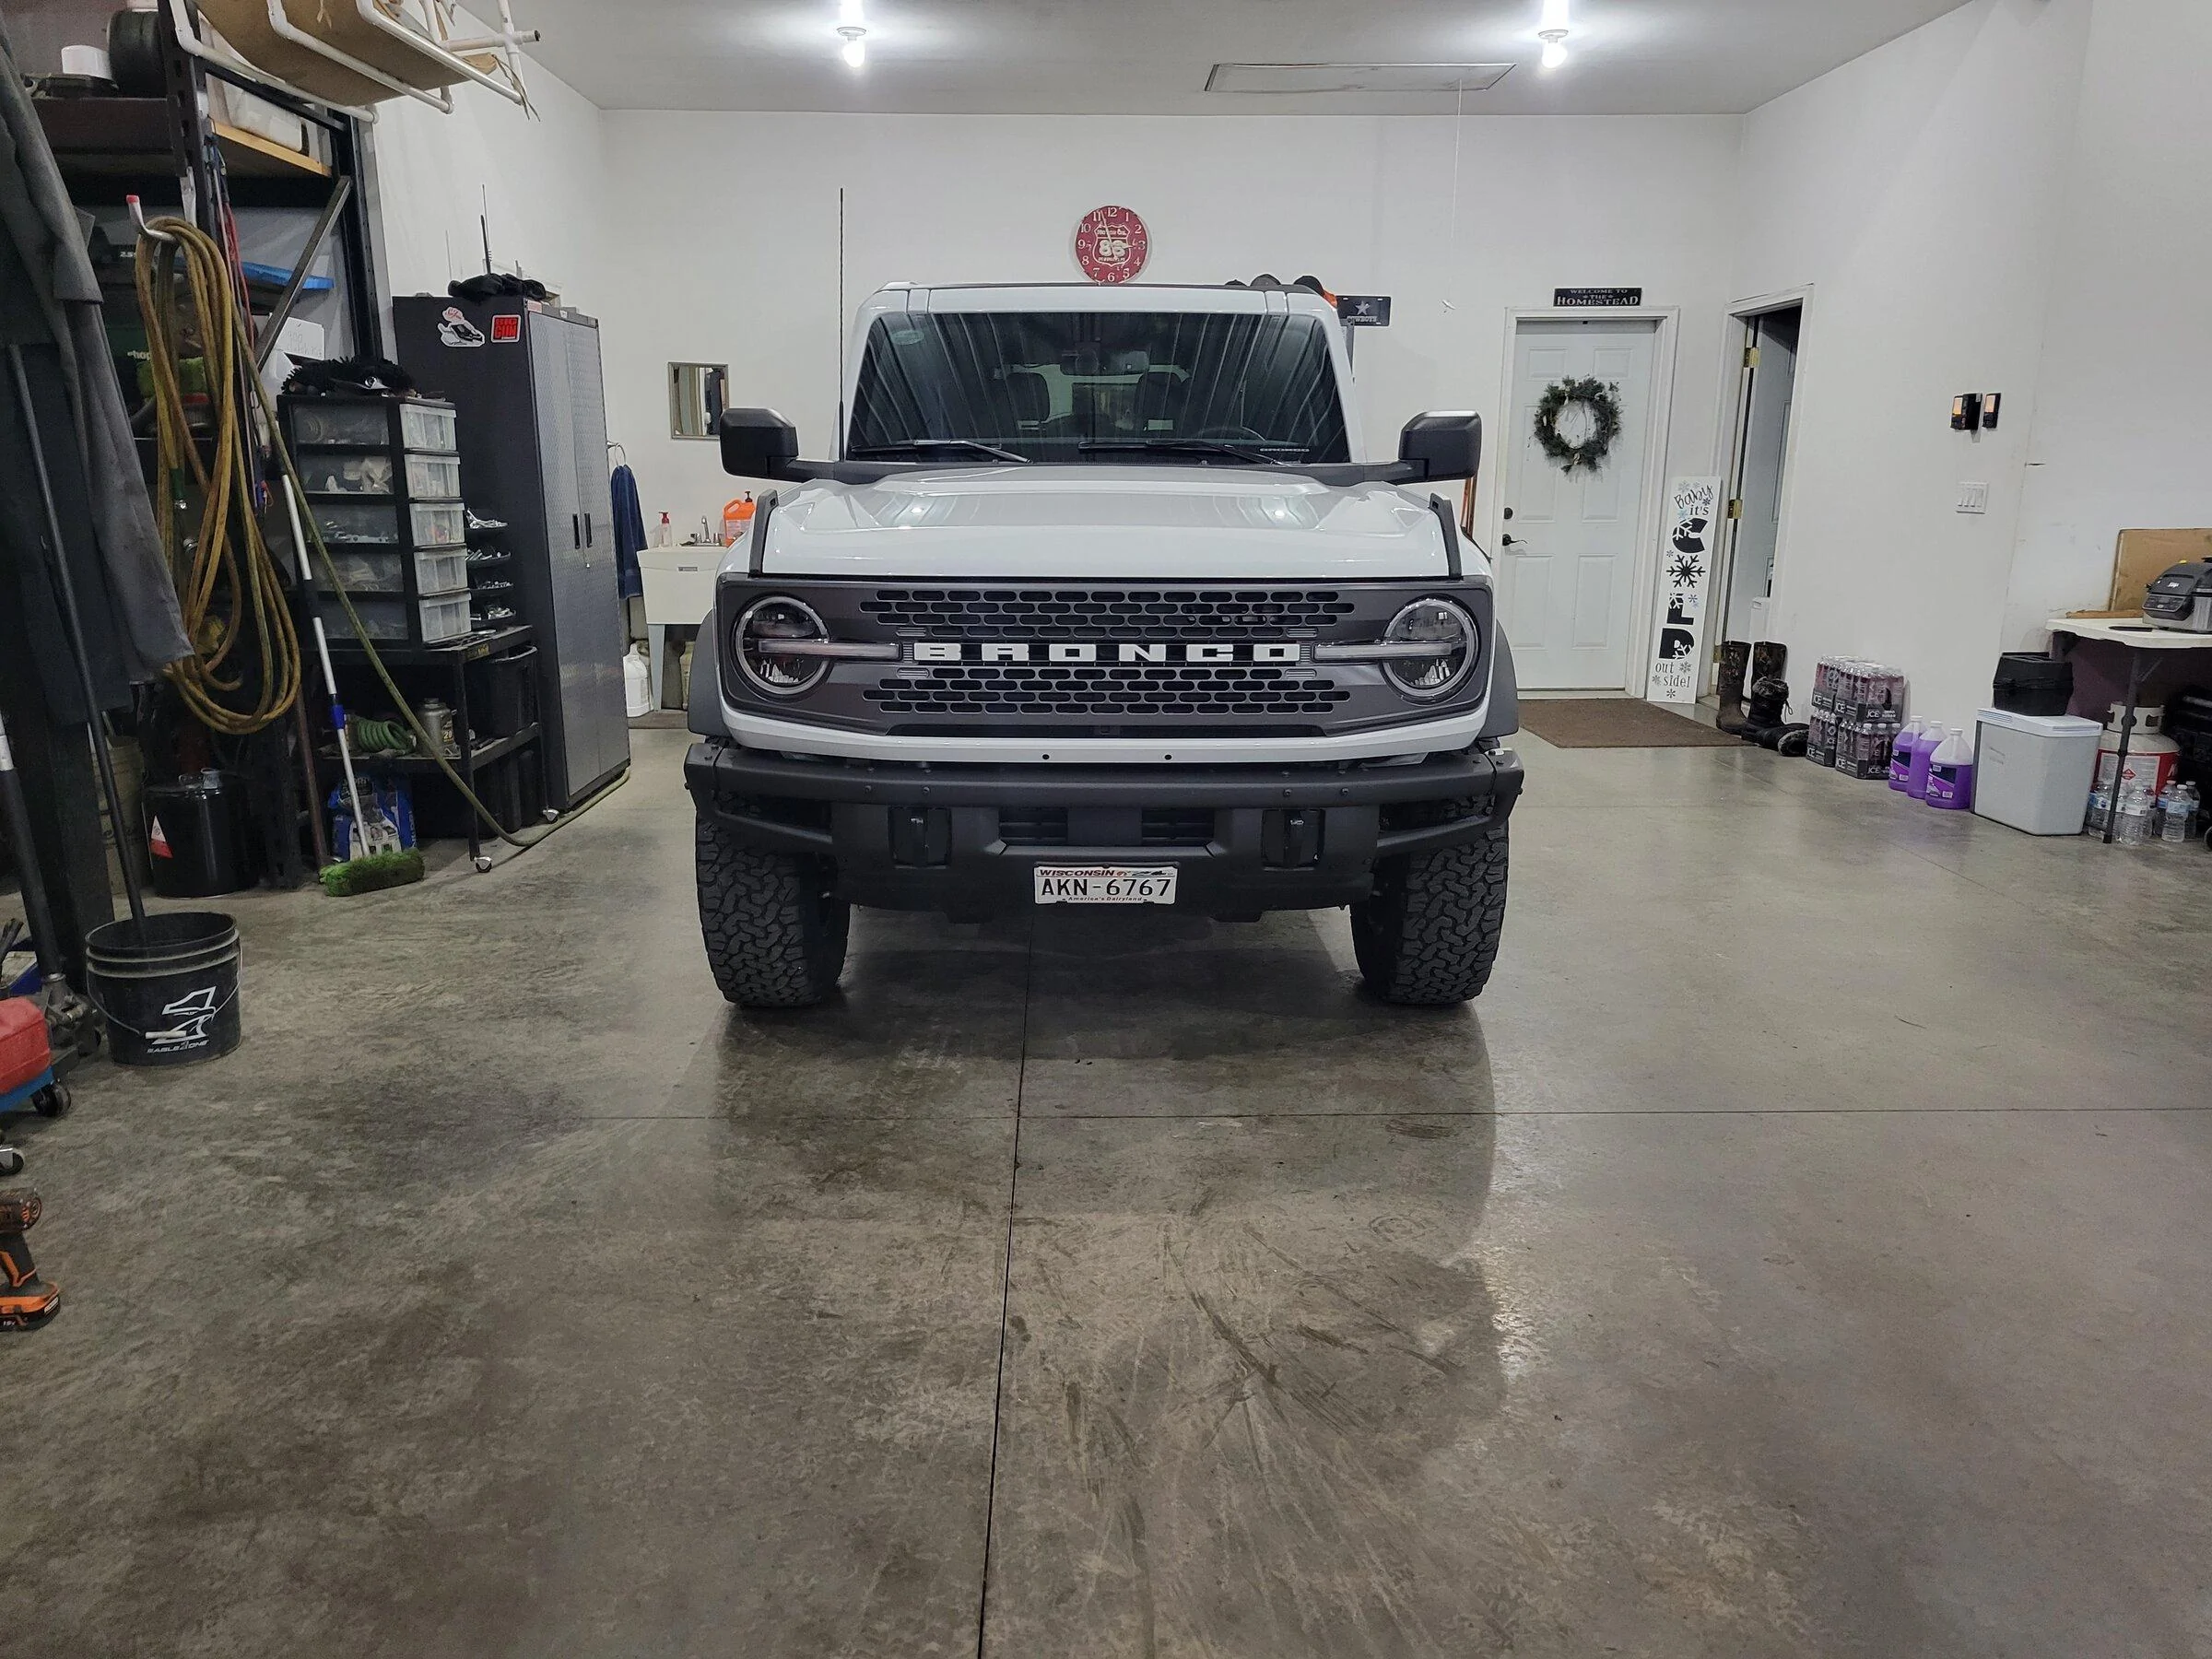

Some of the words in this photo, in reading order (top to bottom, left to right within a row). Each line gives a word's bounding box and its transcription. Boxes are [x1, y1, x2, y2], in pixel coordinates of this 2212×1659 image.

[1093, 211, 1101, 221] 11
[1108, 207, 1117, 217] 12
[1125, 212, 1129, 221] 1
[1081, 223, 1090, 232] 10
[1135, 224, 1142, 233] 2
[1078, 240, 1086, 249] 9
[1138, 241, 1146, 250] 3
[1082, 255, 1089, 265] 8
[1134, 257, 1141, 265] 4
[1093, 267, 1100, 276] 7
[1123, 268, 1130, 278] 5
[1108, 273, 1115, 281] 6
[1557, 295, 1639, 306] HOMESTEAD
[1674, 485, 1714, 509] Baby
[1689, 504, 1710, 516] it's
[1658, 517, 1709, 660] CLD
[913, 643, 1300, 662] BRONCO
[1655, 662, 1675, 674] out
[1041, 878, 1171, 897] AKN-6767
